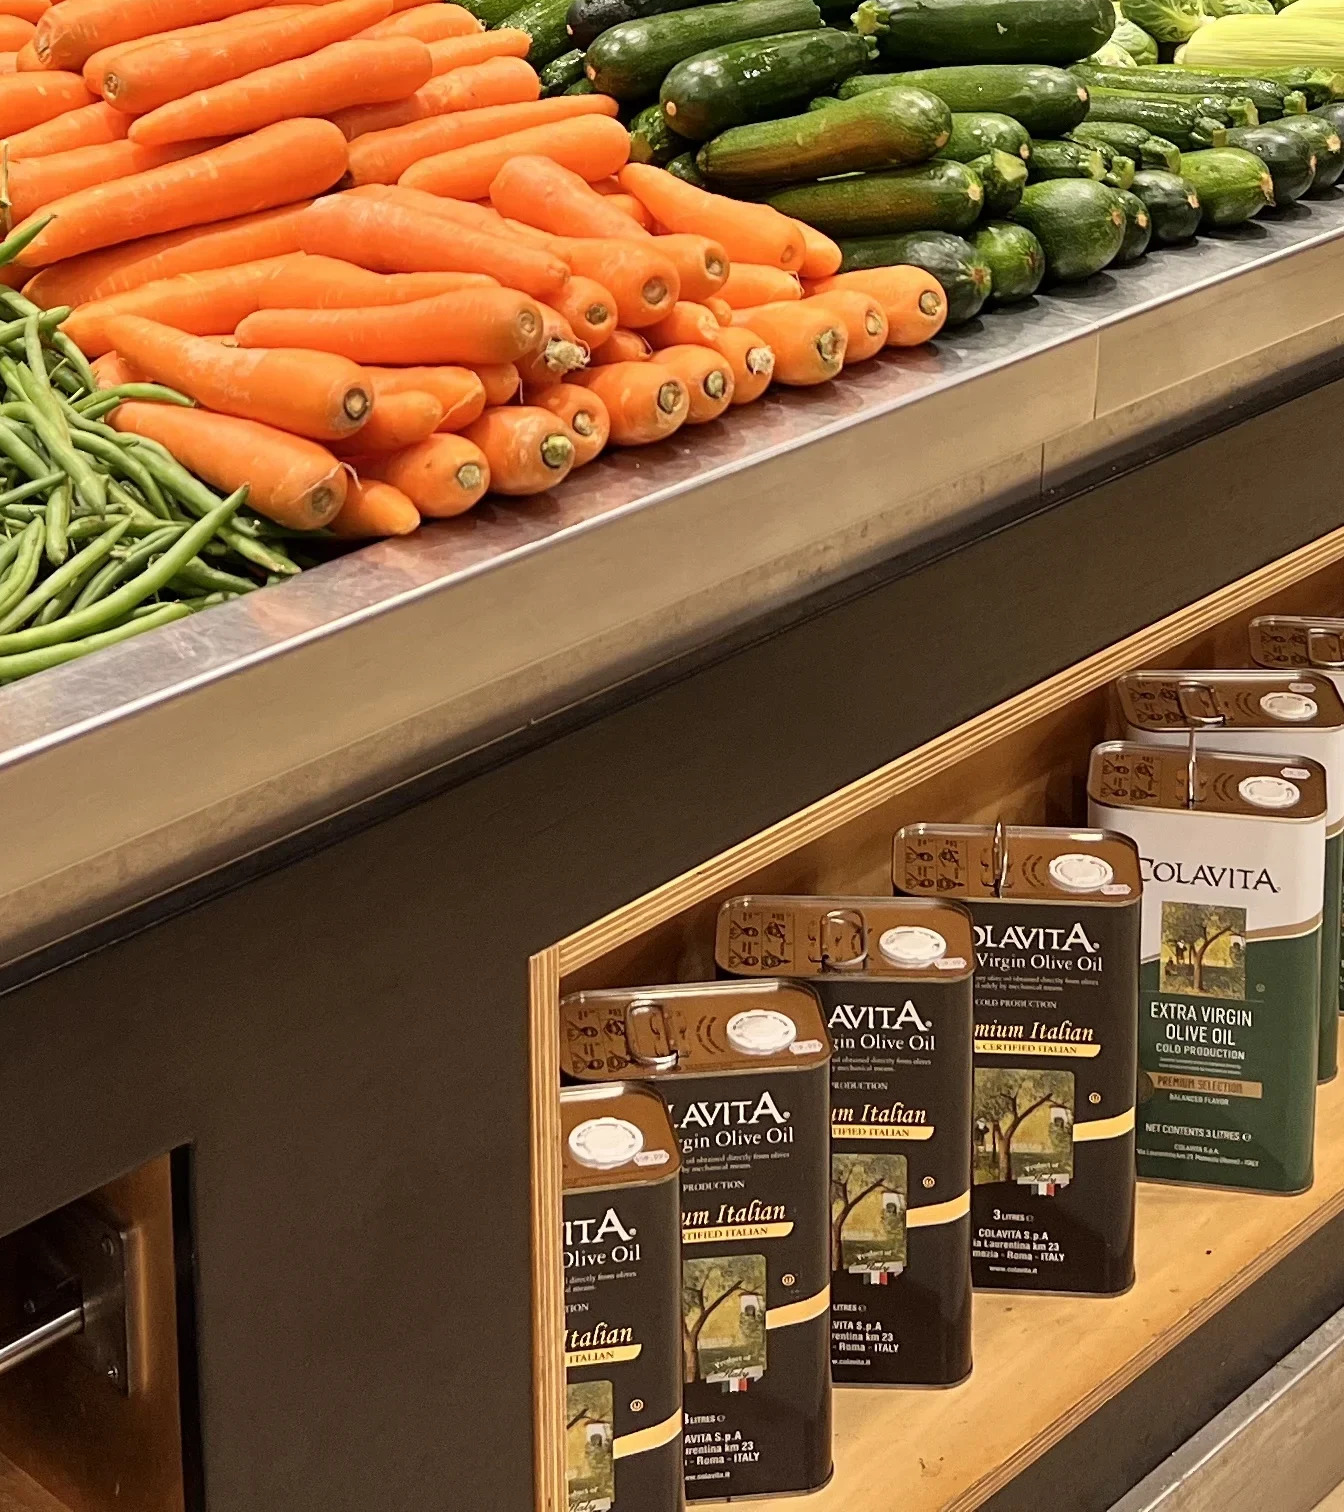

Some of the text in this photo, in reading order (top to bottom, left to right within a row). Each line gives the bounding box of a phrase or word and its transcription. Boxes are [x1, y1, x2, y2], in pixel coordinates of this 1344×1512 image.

[977, 953, 1103, 971] Virgin Olive Oil
[975, 999, 1057, 1008] COLD PRODUCTION
[828, 1000, 929, 1031] AVITA
[1151, 1002, 1252, 1027] EXTRA VIRGIN
[975, 1020, 1093, 1041] mium Italian
[1166, 1024, 1236, 1045] OLIVE OIL
[860, 1034, 935, 1051] Olive Oil
[983, 1043, 1077, 1054] CERTIFIED ITALIAN
[1156, 1043, 1245, 1060] COLD PRODUCTION
[1158, 1075, 1243, 1093] PREMIUM SELECTION
[861, 1102, 927, 1123] Italian
[716, 1127, 794, 1147] Olive Oil
[1146, 1123, 1239, 1141] NET CONTENTS 3 LITRES
[683, 1180, 745, 1192] PRODUCTION
[716, 1200, 785, 1223] Italian
[993, 1209, 1000, 1220] 3
[726, 1227, 768, 1237] ITALIAN
[979, 1228, 1021, 1239] COLAVITA
[984, 1239, 1030, 1249] Laurentina
[1048, 1243, 1059, 1251] 23
[611, 1243, 641, 1263] Oil
[973, 1250, 1064, 1262] mezia Roma ITALY
[866, 1332, 893, 1342] km 23
[839, 1342, 899, 1352] Roma ITALY
[569, 1350, 614, 1363] ITALIAN
[725, 1441, 753, 1452] km 23
[697, 1452, 759, 1465] Roma ITALY
